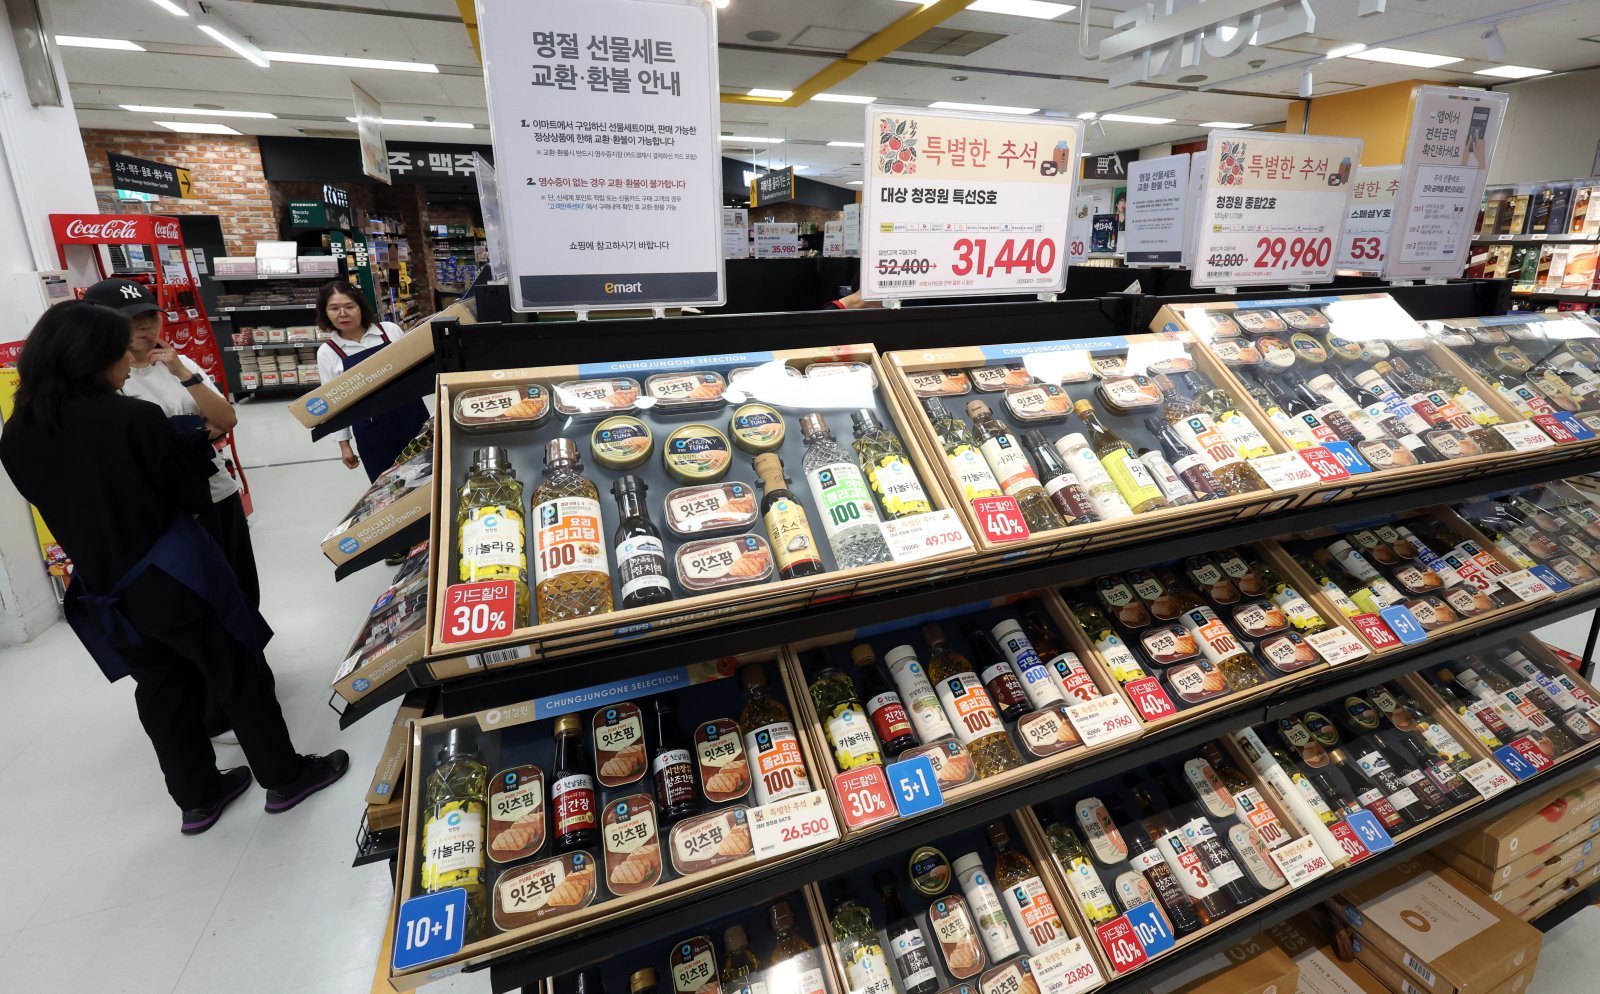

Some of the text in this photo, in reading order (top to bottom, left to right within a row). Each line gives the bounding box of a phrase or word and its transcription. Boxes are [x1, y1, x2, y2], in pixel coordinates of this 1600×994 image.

[532, 31, 676, 65] 명절 선물세트
[531, 64, 682, 98] 교환·환불 안내
[533, 120, 573, 130] 이마트에서
[575, 121, 607, 132] 구입하신
[608, 122, 656, 134] 선물세트이며,
[658, 123, 673, 134] 판매
[675, 124, 697, 136] 가능한
[534, 132, 675, 147] 정상상품에 한해 교환·환불이 가능합니다
[922, 136, 1038, 170] 특별한 추석
[1421, 143, 1460, 158] 확인하세요
[1139, 170, 1176, 183] 명절 선물세트
[1248, 155, 1329, 181] 특별한 추석
[527, 177, 536, 185] 2.
[539, 177, 571, 187] 영수증이
[573, 178, 588, 187] 없는
[590, 178, 606, 188] 경우
[650, 179, 686, 189] 불가합니다
[1164, 179, 1177, 190] 안내
[575, 194, 592, 202] 포인트
[881, 187, 998, 205] 대상 청정원 특선S호
[1216, 196, 1277, 210] 청정원 종합2호
[292, 209, 309, 217] Ready
[66, 219, 138, 239] Coca-Cola
[154, 221, 178, 240] Coca-Cola
[570, 240, 669, 251] 쇼핑에 참고하시기 바랍니다
[1254, 237, 1332, 270] 29,960
[878, 258, 930, 277] 52,400
[951, 238, 1056, 278] 31,440
[1208, 254, 1243, 268] 42,800
[605, 281, 642, 295] emart
[1003, 341, 1112, 355] CHUNGJUNGONE SELECTION
[611, 354, 748, 371] CHUNGJUNGONE SELECTION
[658, 382, 694, 396] 잇츠팜
[750, 419, 768, 427] TUNA
[612, 432, 633, 441] TUNA
[686, 437, 717, 447] CHUNKY
[688, 443, 711, 452] TUNA
[1303, 450, 1331, 460] 카드할인
[1312, 460, 1343, 478] 30%
[680, 497, 720, 518] 잇츠팜
[829, 501, 861, 526] 100
[978, 500, 1015, 513] 카드할인
[570, 518, 591, 527] 요리
[987, 514, 1023, 536] 40%
[543, 527, 596, 546] 올리고당
[926, 531, 962, 547] 49,700
[540, 543, 576, 572] 100
[691, 551, 734, 575] 잇츠팜
[632, 562, 663, 577] 참치액
[1469, 573, 1490, 592] 3
[453, 586, 509, 604] 카드할인
[451, 603, 507, 637] 30%
[1357, 617, 1382, 629] 카드할인
[1394, 613, 1416, 634] 5+1
[1366, 626, 1395, 645] 30%
[1341, 642, 1363, 656] 31,440
[1025, 667, 1049, 685] 800
[546, 673, 680, 711] CHUNGJUNGONE SELECTION
[1131, 681, 1158, 695] 카드할인
[1141, 695, 1171, 717] 40%
[963, 709, 990, 735] 100
[1103, 714, 1133, 732] 29,960
[601, 726, 635, 748] 잇츠팜
[782, 742, 797, 751] 요리
[838, 732, 871, 748] 카놀라유
[704, 743, 736, 763] 잇츠팜
[762, 750, 803, 772] 올리고당
[1506, 752, 1528, 772] 5+1
[1524, 751, 1550, 769] 30%
[764, 768, 794, 795] 100
[842, 773, 877, 793] 카드할인
[900, 767, 930, 803] 5+1
[497, 790, 536, 812] 잇츠팜
[557, 797, 590, 817] 진간장
[848, 789, 886, 818] 30%
[612, 822, 648, 849] 잇츠팜
[780, 816, 829, 843] 26,500
[1362, 820, 1386, 843] 3+1
[432, 840, 477, 860] 카놀라유
[683, 826, 724, 857] 잇츠팜
[1188, 864, 1208, 889] 3
[510, 873, 556, 907] 잇츠팜
[406, 902, 455, 952] 10+1
[1030, 924, 1055, 947] 100
[1101, 922, 1130, 943] 카드할인
[1134, 911, 1167, 948] 10+1
[1111, 938, 1142, 967] 40%
[1065, 963, 1094, 985] 23,800
